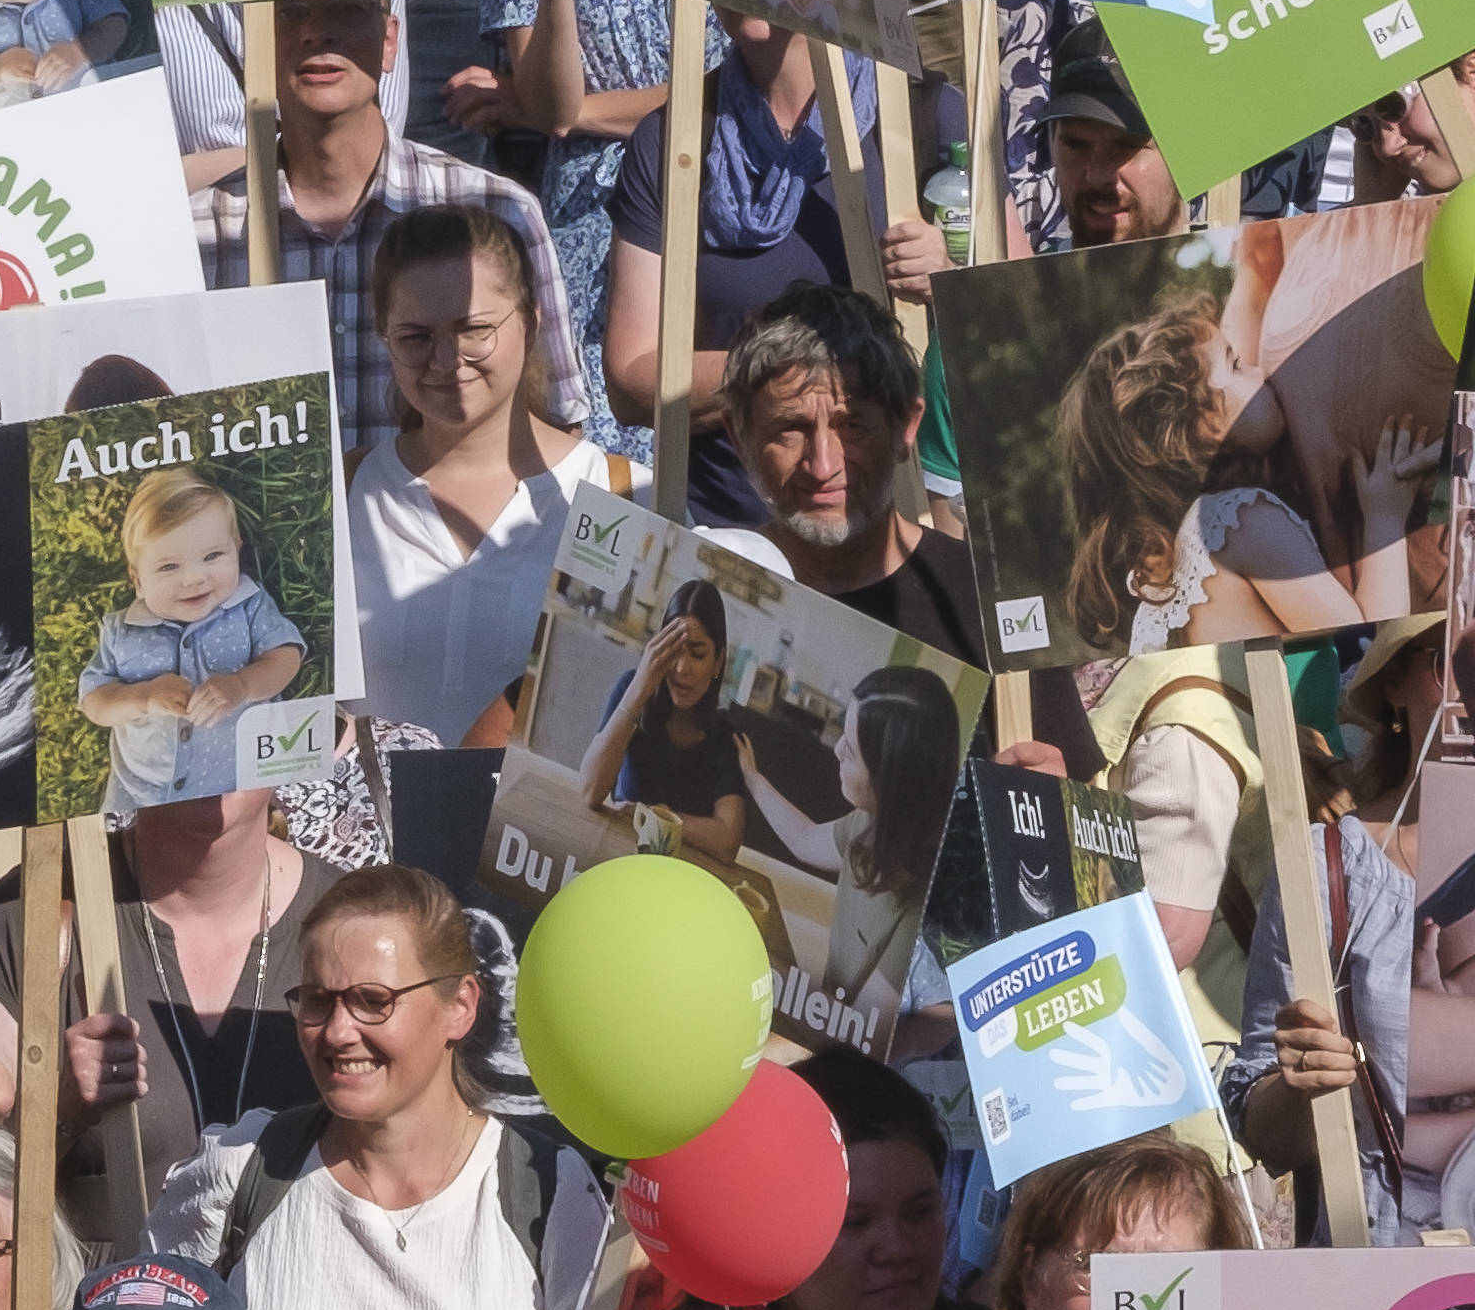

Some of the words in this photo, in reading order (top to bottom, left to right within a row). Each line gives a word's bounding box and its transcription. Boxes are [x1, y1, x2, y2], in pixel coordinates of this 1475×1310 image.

[55, 419, 193, 485] Auch
[211, 401, 309, 459] ich!
[969, 941, 1084, 1022] UNTERSTÜTZE
[1024, 981, 1106, 1041] LEBEN
